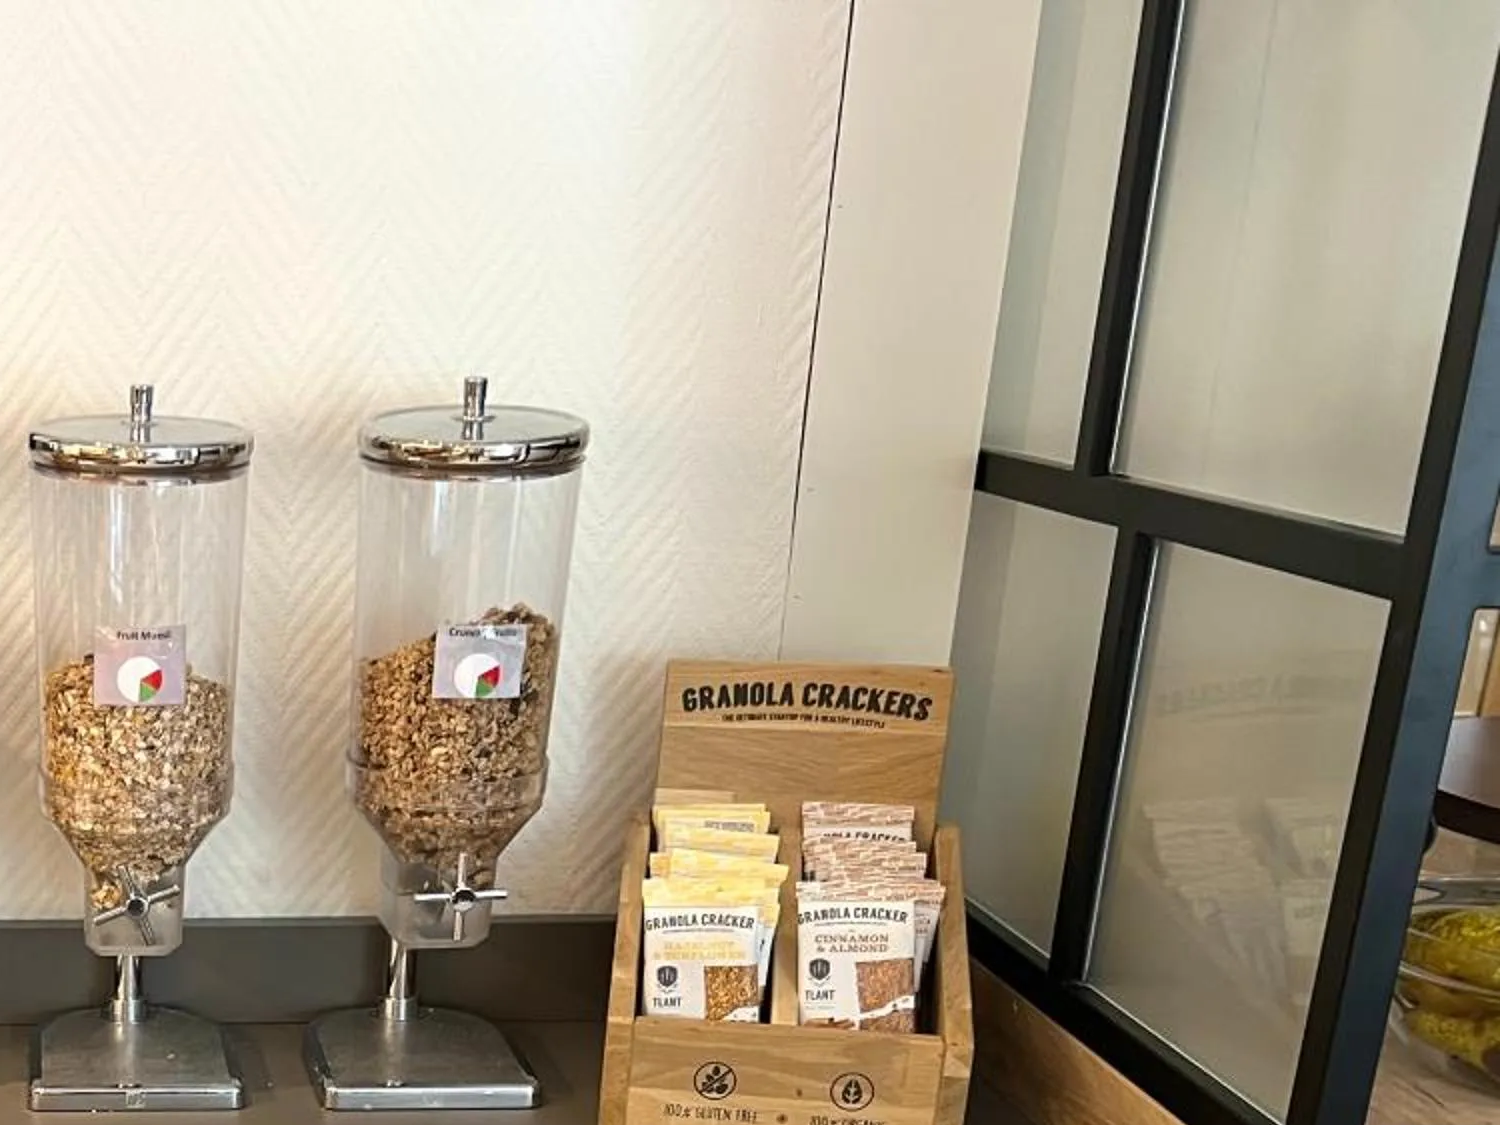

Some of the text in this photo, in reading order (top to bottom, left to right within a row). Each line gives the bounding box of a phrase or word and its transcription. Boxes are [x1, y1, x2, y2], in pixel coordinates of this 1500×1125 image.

[681, 681, 933, 722] GRANOLA CRACKERS
[645, 912, 755, 932] GRANOLA CRACKER
[797, 907, 850, 926] GRANOLA
[853, 906, 909, 925] CRACKER
[814, 933, 889, 944] CINNAMON
[829, 943, 889, 953] ALMOND
[805, 989, 836, 1002] TLANT
[652, 997, 682, 1008] TLANT
